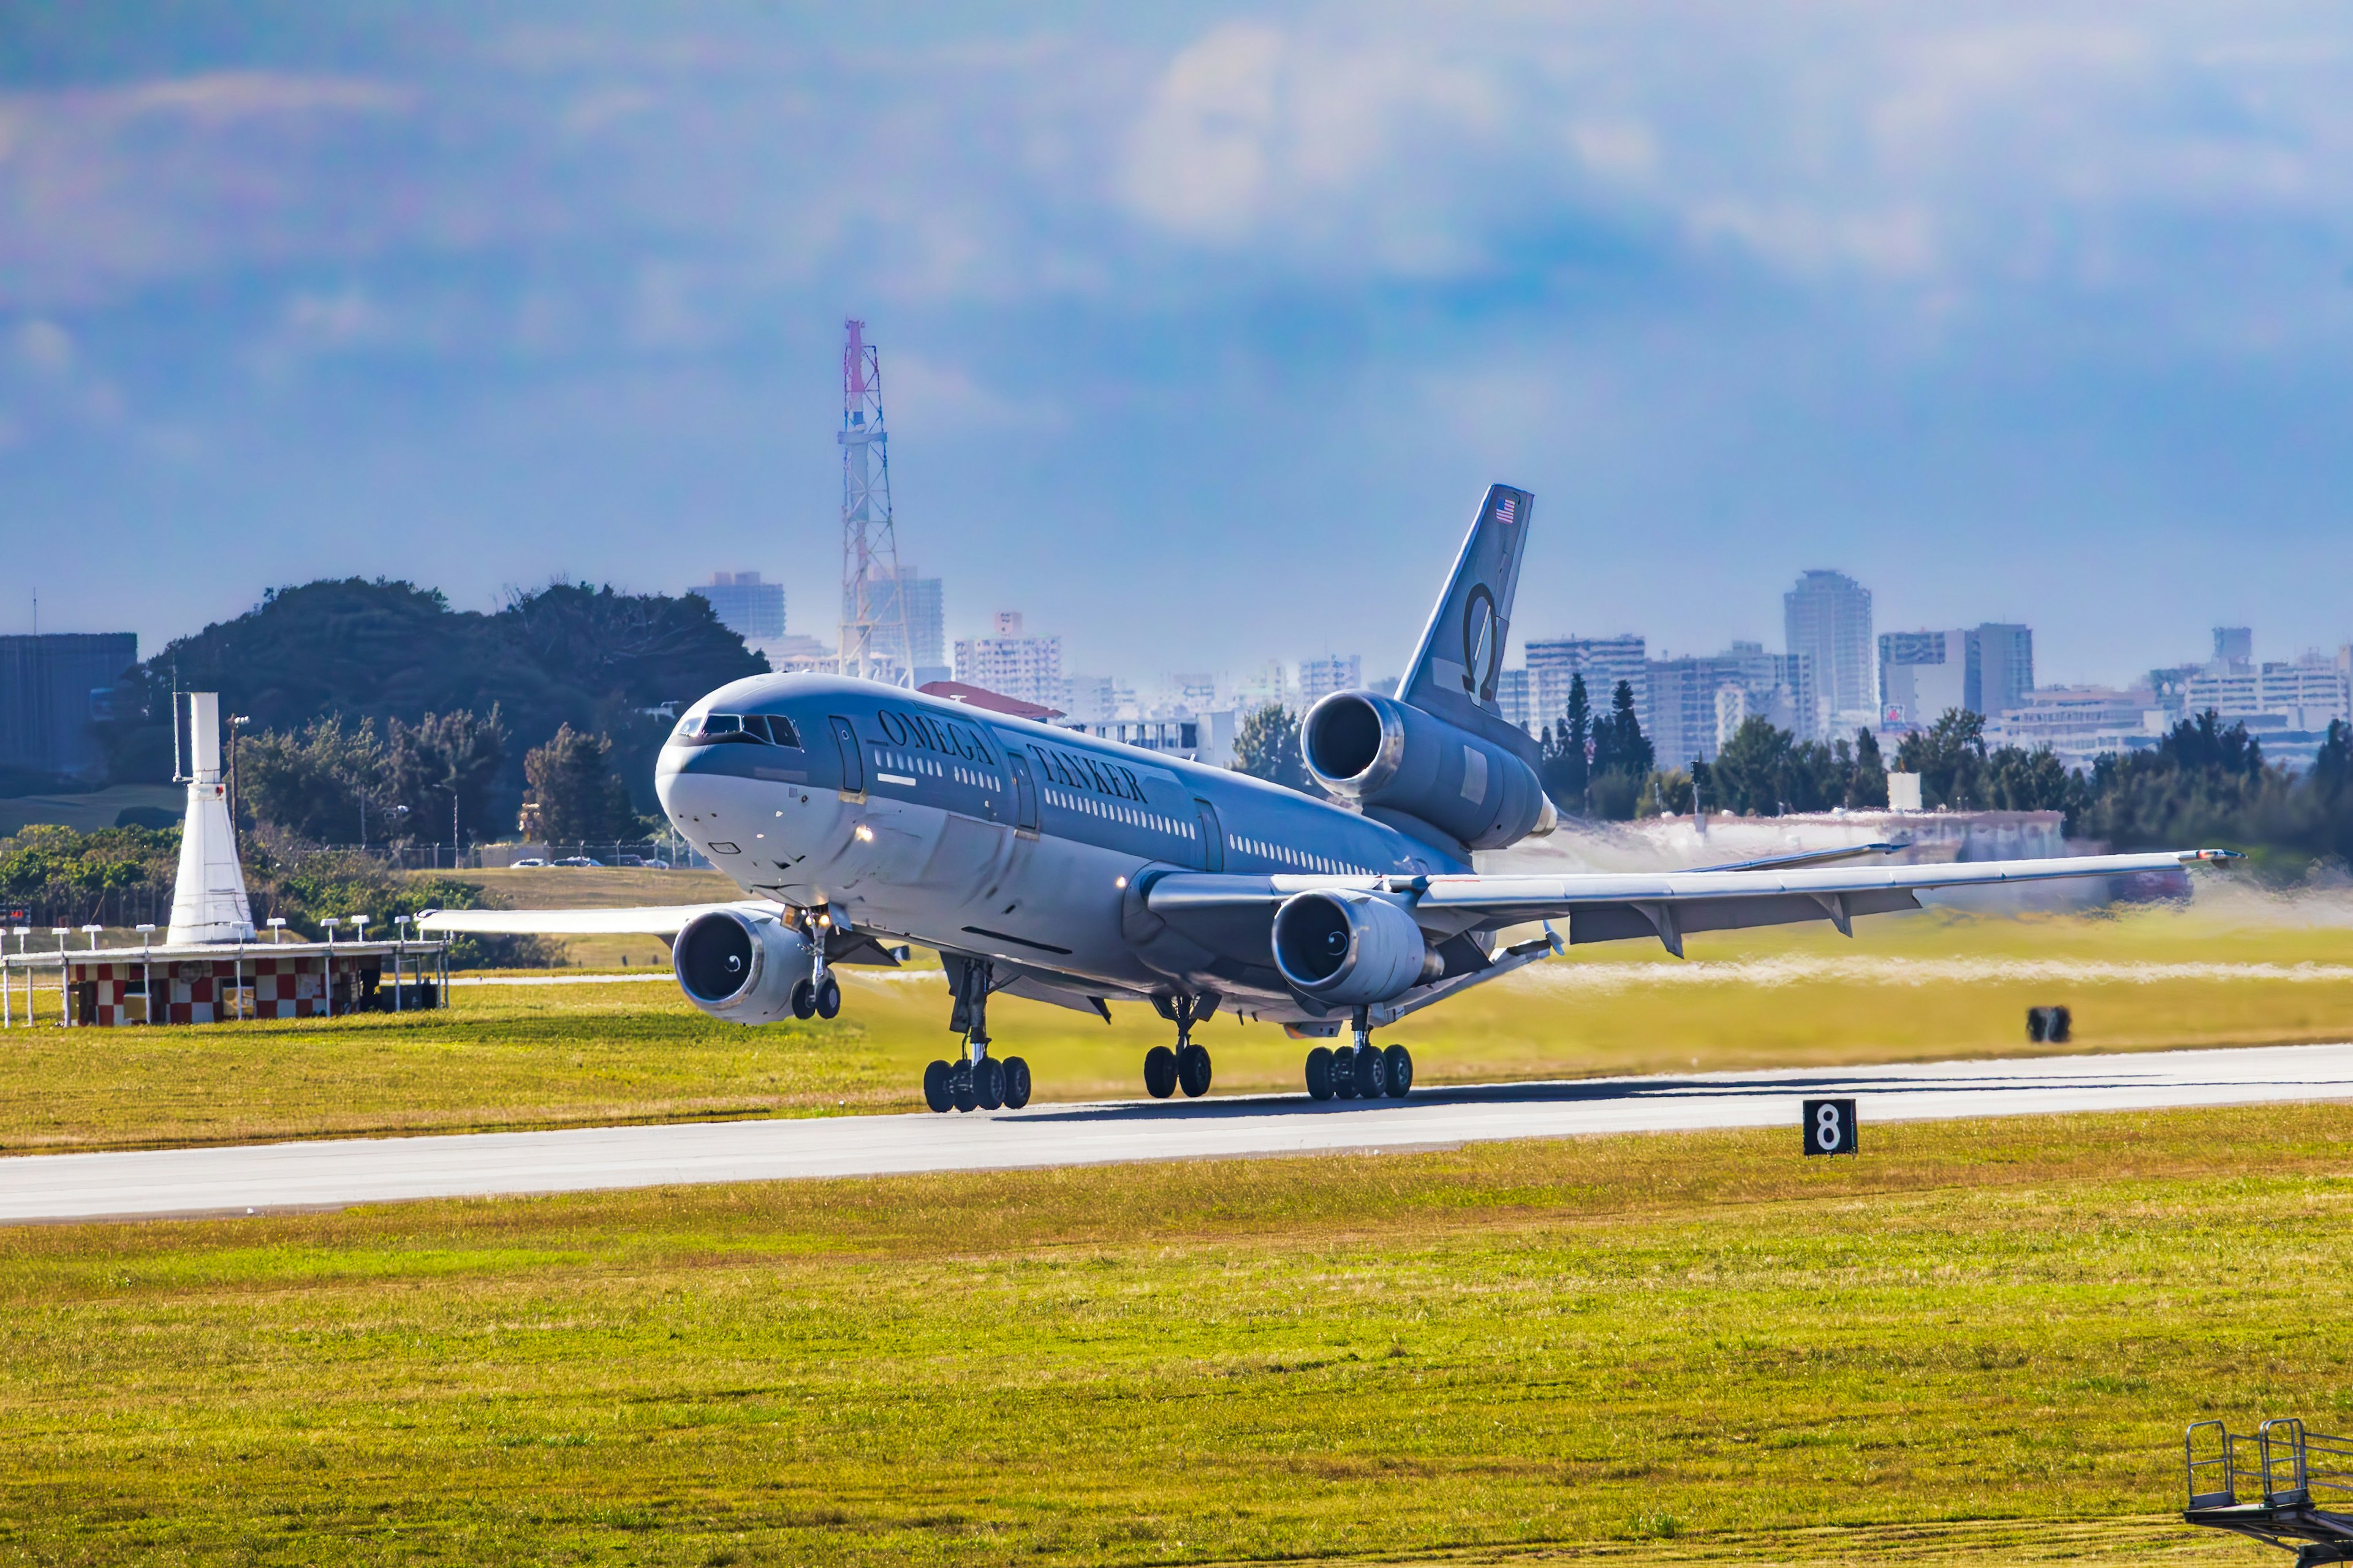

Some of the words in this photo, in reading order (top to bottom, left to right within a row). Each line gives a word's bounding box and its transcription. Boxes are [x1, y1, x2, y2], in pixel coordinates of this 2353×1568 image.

[877, 709, 995, 765] OMEGA
[1026, 743, 1148, 804] TANKER
[1817, 1104, 1841, 1150] 8
